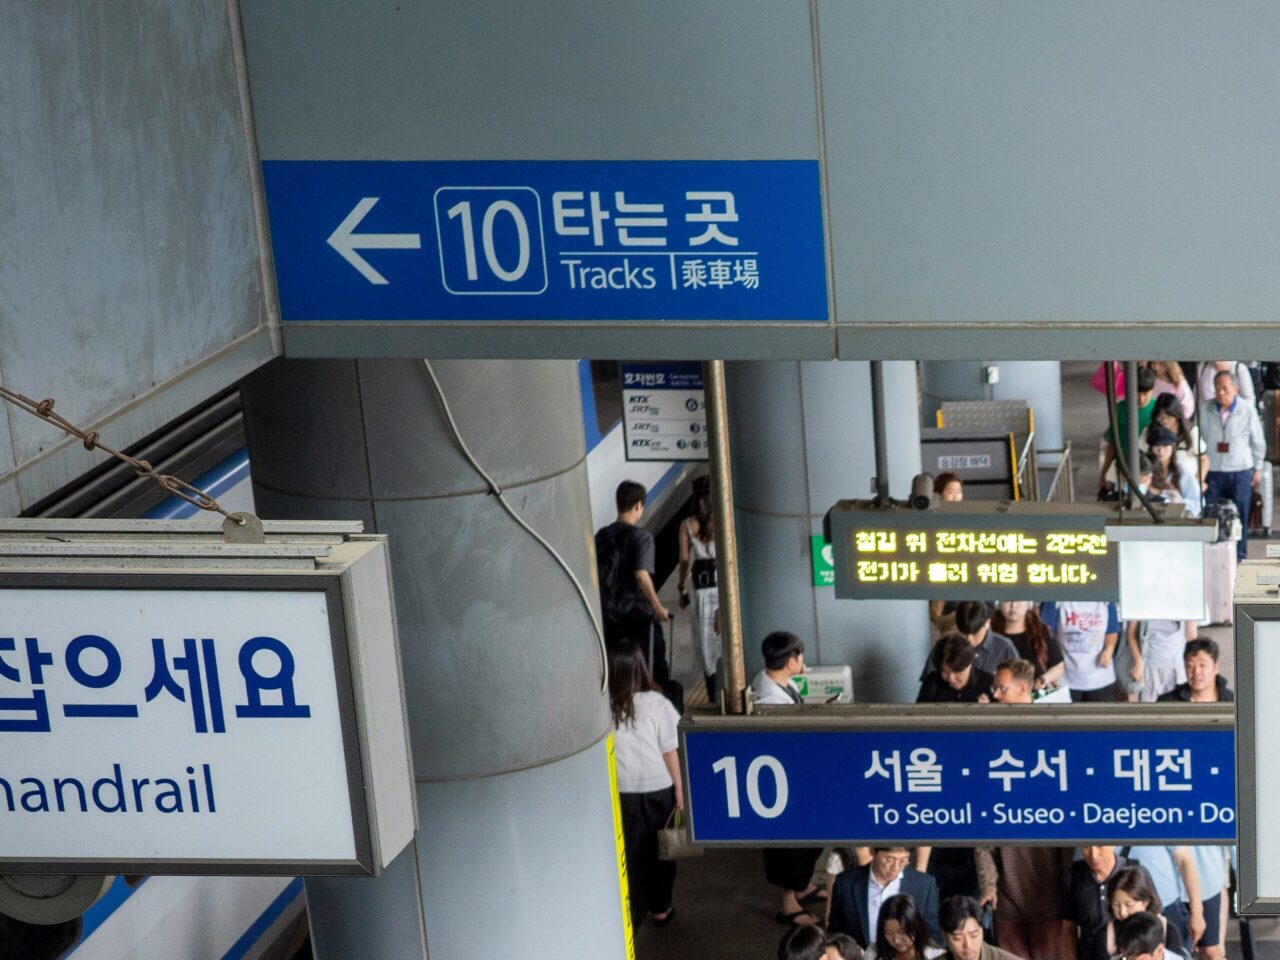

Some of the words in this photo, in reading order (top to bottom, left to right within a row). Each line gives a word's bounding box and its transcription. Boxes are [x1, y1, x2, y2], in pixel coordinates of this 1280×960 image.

[552, 191, 668, 246] 타는
[684, 190, 740, 246] 곳
[447, 200, 531, 281] 10
[560, 258, 657, 290] Tracks
[906, 532, 926, 552] 위
[857, 561, 920, 582] 전기가
[977, 562, 1018, 582] 위험
[712, 755, 789, 819] 10
[864, 747, 943, 793] 서울
[988, 748, 1068, 792] 수서
[1113, 748, 1193, 793] 대전
[869, 804, 899, 824] To
[907, 803, 972, 825] Seoul
[993, 804, 1064, 825] Suseo
[1083, 803, 1183, 829] Daejeon
